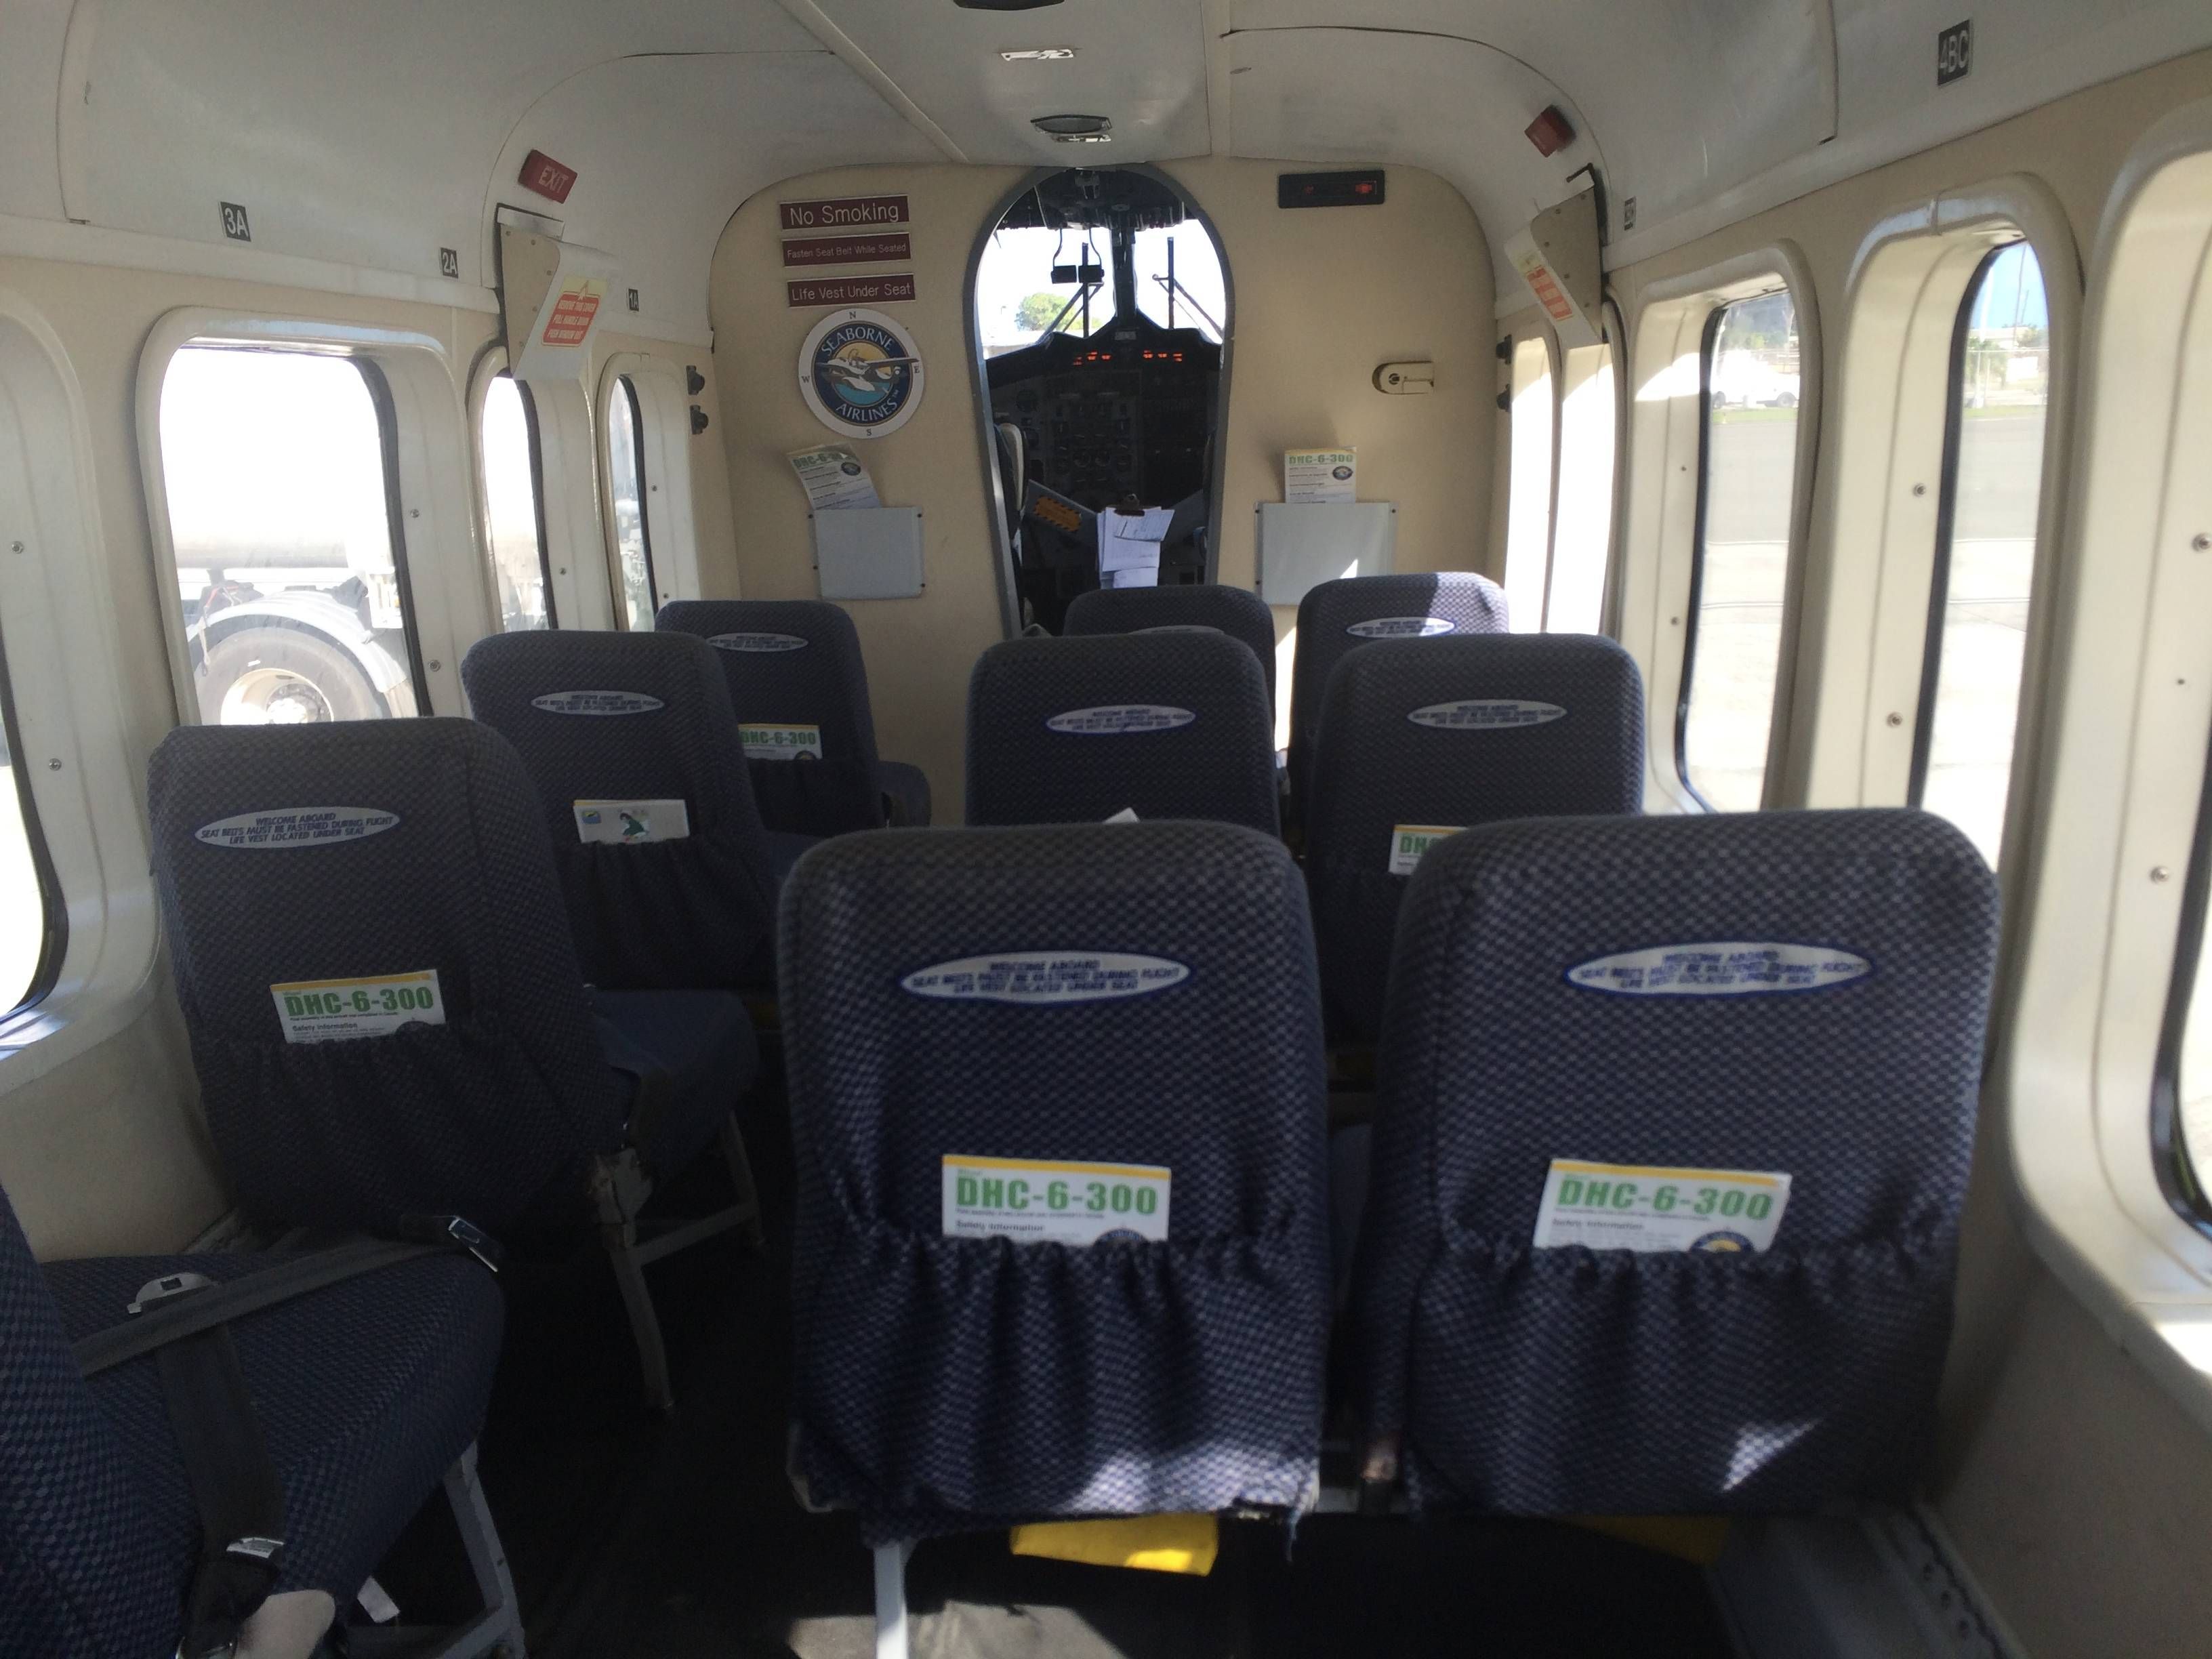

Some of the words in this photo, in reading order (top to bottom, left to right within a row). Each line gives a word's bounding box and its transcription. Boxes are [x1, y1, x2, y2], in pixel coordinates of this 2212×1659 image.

[539, 165, 569, 193] EXIT
[224, 208, 249, 237] 3A
[790, 207, 813, 226] No
[822, 203, 899, 223] Smoking
[443, 251, 458, 274] 2A
[787, 249, 813, 259] Fasten
[816, 247, 834, 257] Seat
[836, 247, 852, 255] Belt
[855, 245, 876, 254] While
[878, 243, 906, 253] Seated
[792, 288, 815, 301] Life
[818, 285, 844, 299] Vest
[848, 285, 879, 298] Under
[884, 282, 911, 296] Seat
[821, 326, 894, 356] SEABORNE
[802, 375, 810, 384] W
[836, 398, 897, 422] AIRLINES
[201, 829, 220, 838] SEAT
[222, 827, 244, 837] BELTS
[246, 825, 271, 836] MUST
[287, 821, 329, 833] FASTENED
[331, 819, 363, 830] DURING
[365, 816, 394, 827] FLIGHT
[255, 815, 297, 826] WELCOME
[299, 813, 336, 823] ABOARD
[230, 836, 244, 845] LIFE
[247, 834, 268, 843] VEST
[271, 832, 310, 842] LOCATED
[313, 830, 341, 839] UNDER
[345, 827, 365, 836] SEAT
[283, 986, 434, 1017] DHC-6-300
[956, 1176, 1158, 1215] DHC-6-300
[1558, 1179, 1774, 1221] DHC-6-300
